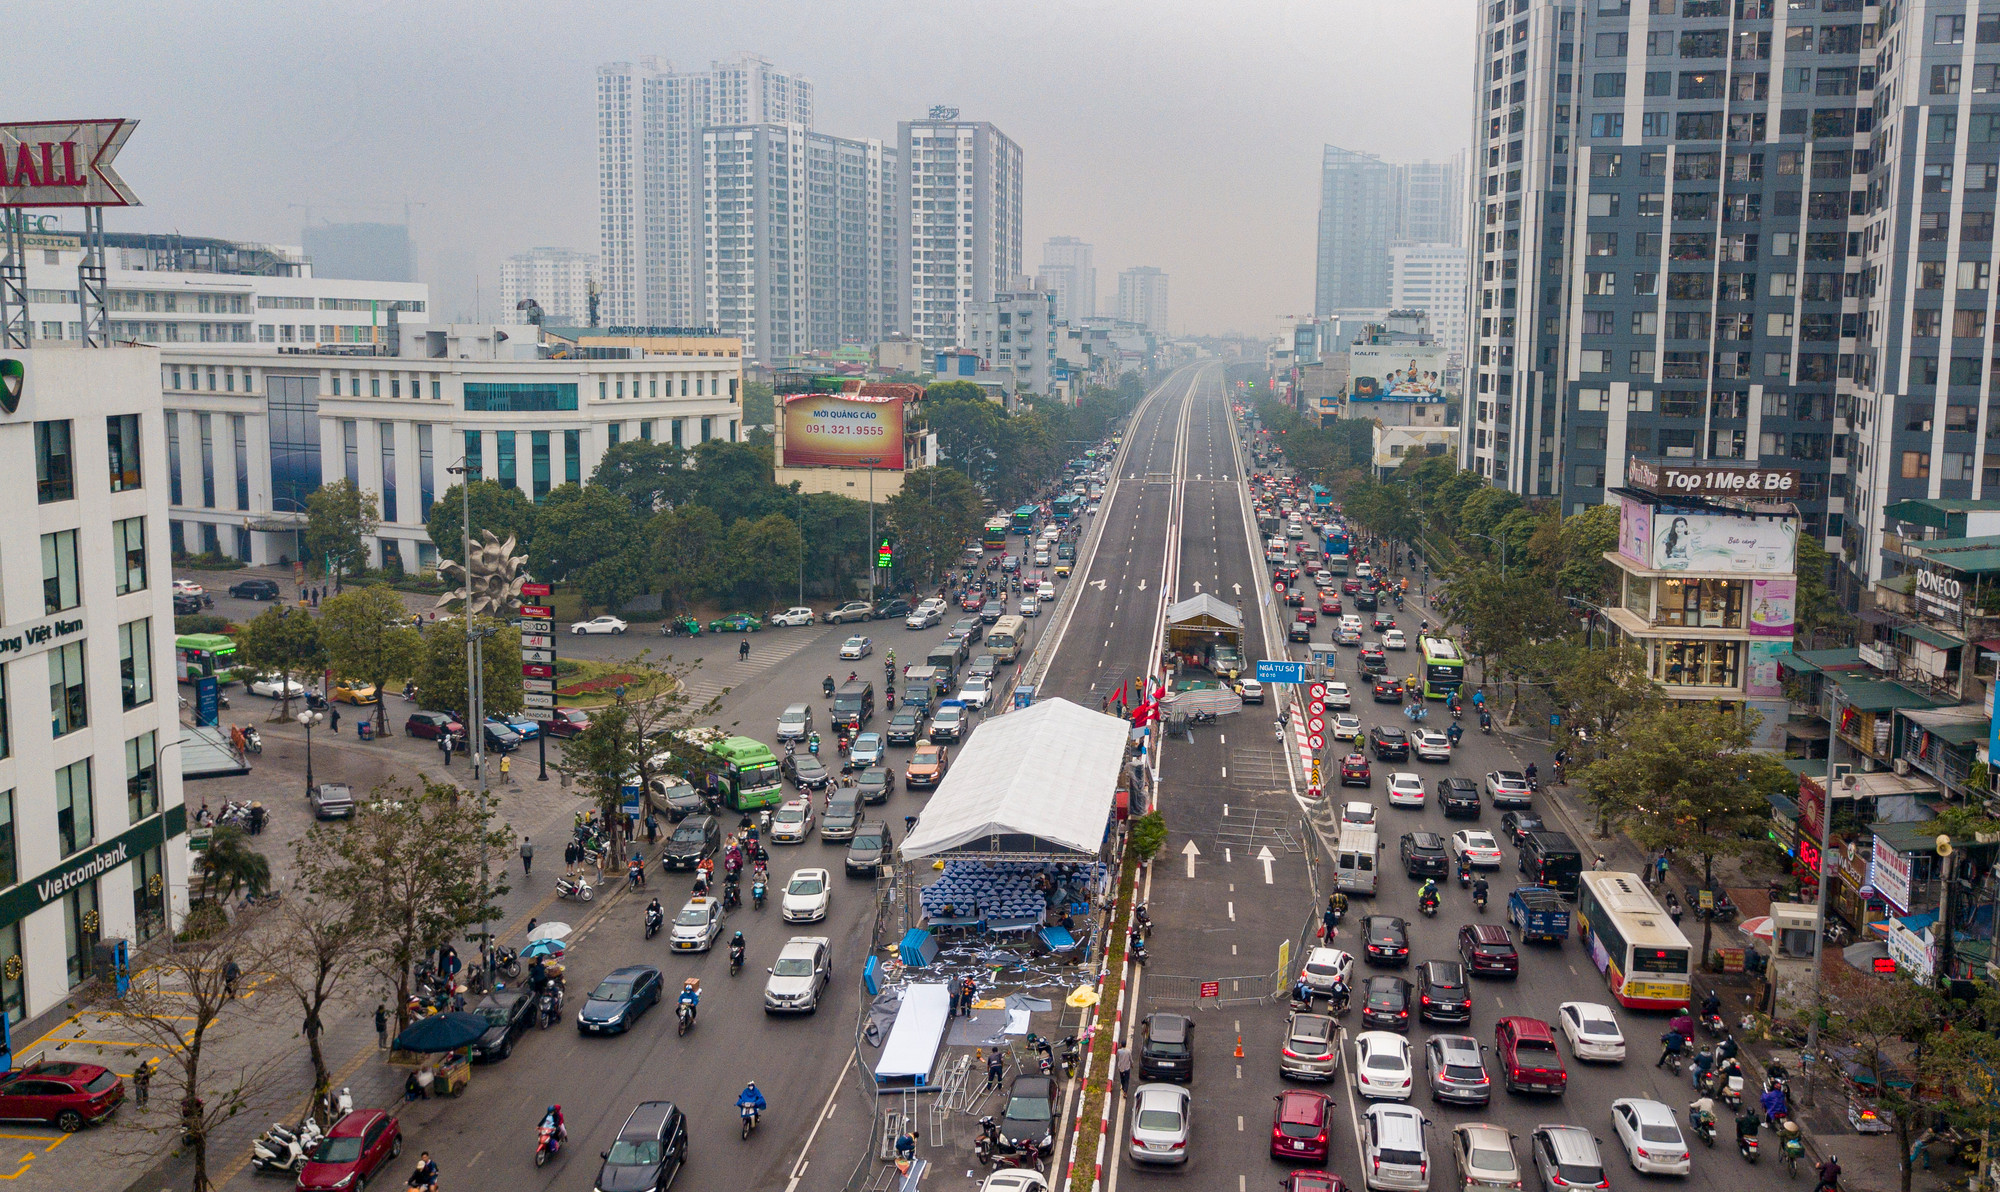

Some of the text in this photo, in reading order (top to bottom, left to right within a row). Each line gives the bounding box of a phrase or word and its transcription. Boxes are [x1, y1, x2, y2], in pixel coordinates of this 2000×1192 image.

[0, 141, 87, 187] ALL
[813, 409, 829, 418] MỜI
[860, 411, 877, 419] CÁO
[806, 424, 884, 436] 091.321.9555
[1665, 471, 1701, 492] Top
[1705, 472, 1712, 489] 1
[1714, 472, 1745, 492] Mẹ
[1746, 472, 1760, 489] &
[1764, 472, 1792, 490] Bé
[1916, 568, 1960, 599] BONECO
[25, 625, 52, 645] Việt
[55, 618, 84, 638] Nam
[37, 842, 128, 902] Vietcombank
